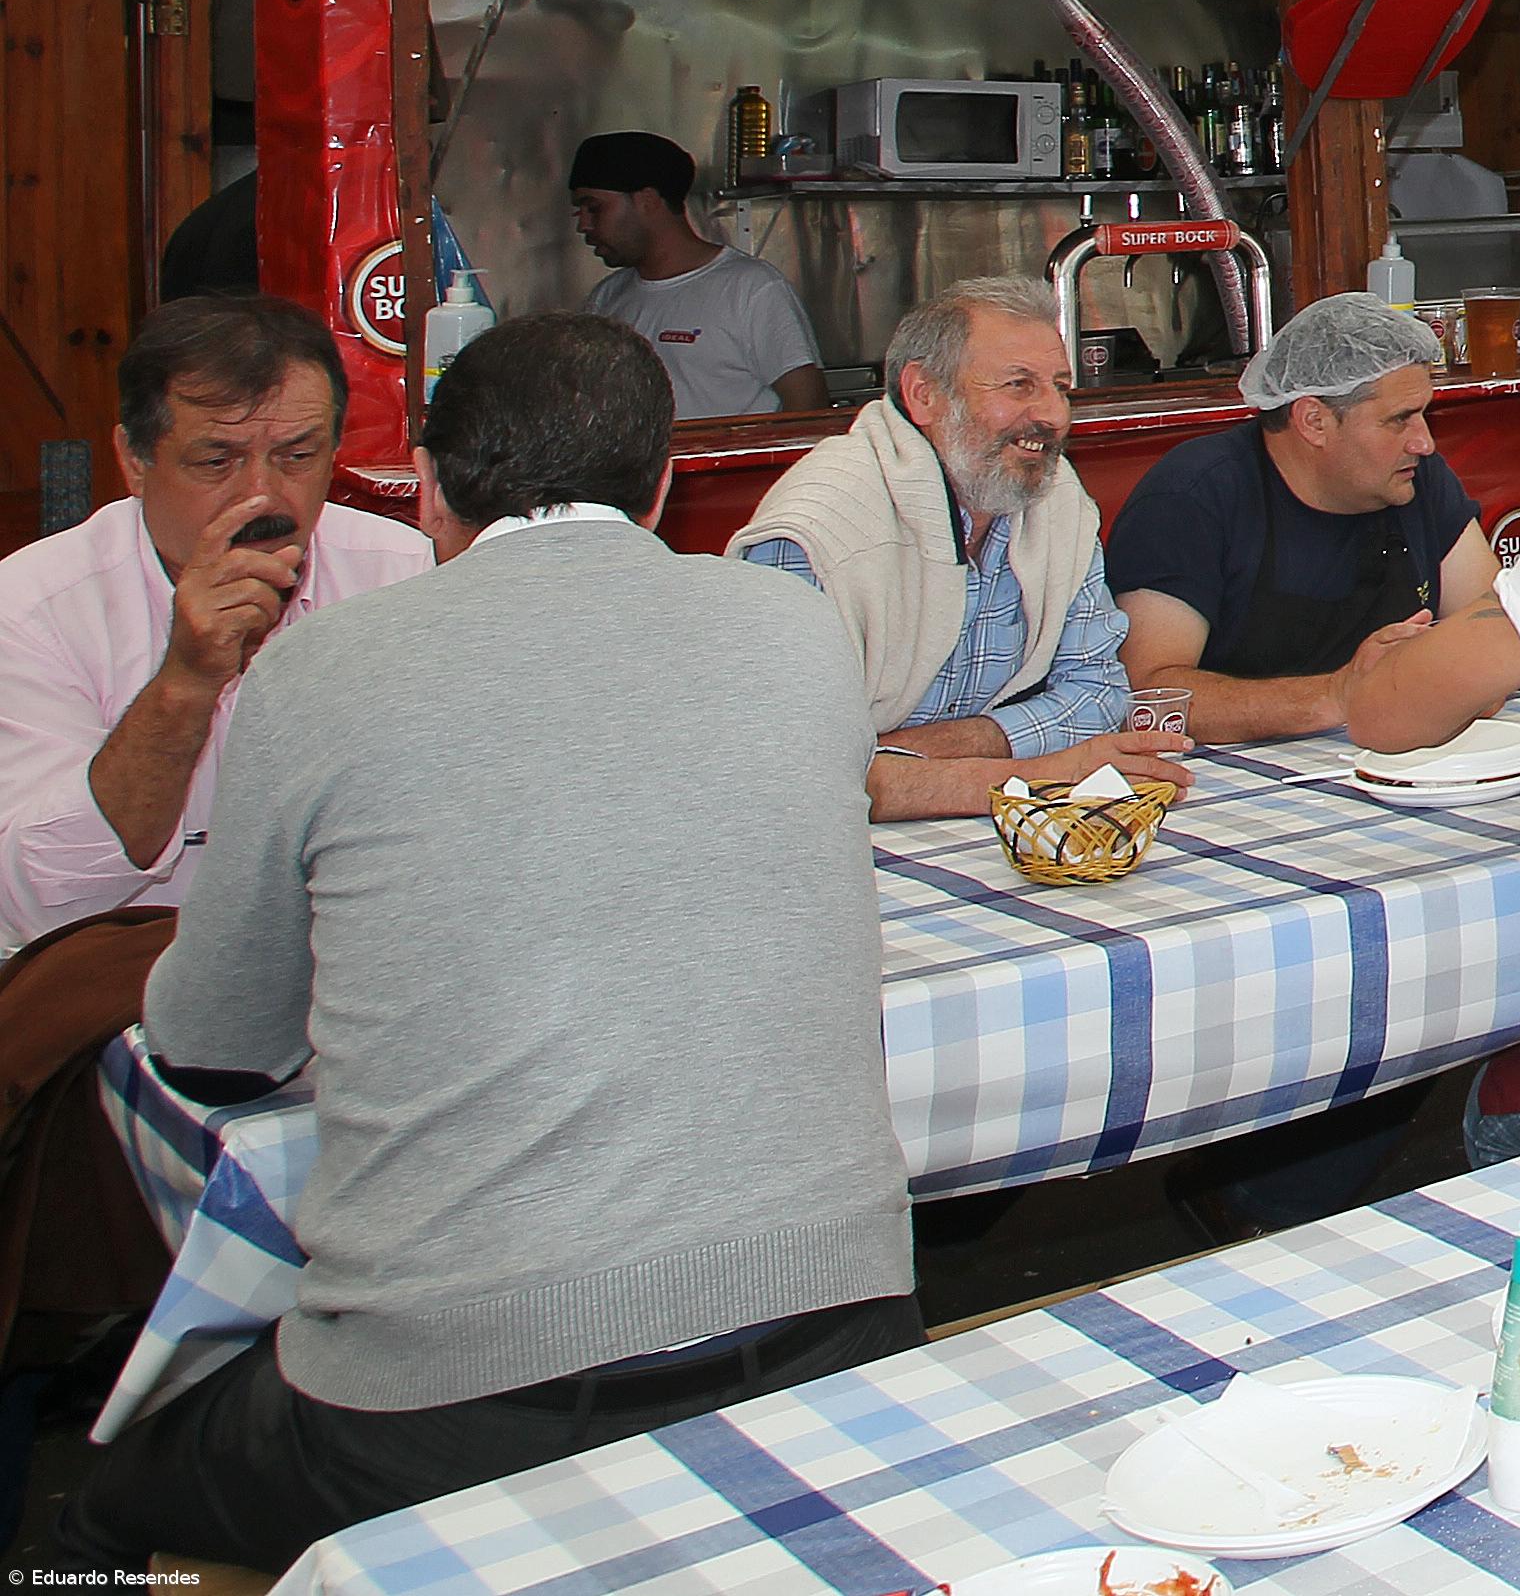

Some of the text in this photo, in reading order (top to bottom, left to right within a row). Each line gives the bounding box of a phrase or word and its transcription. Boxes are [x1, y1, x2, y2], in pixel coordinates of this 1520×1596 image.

[1120, 228, 1218, 246] SUPER BOCK
[660, 331, 695, 344] IDEAL
